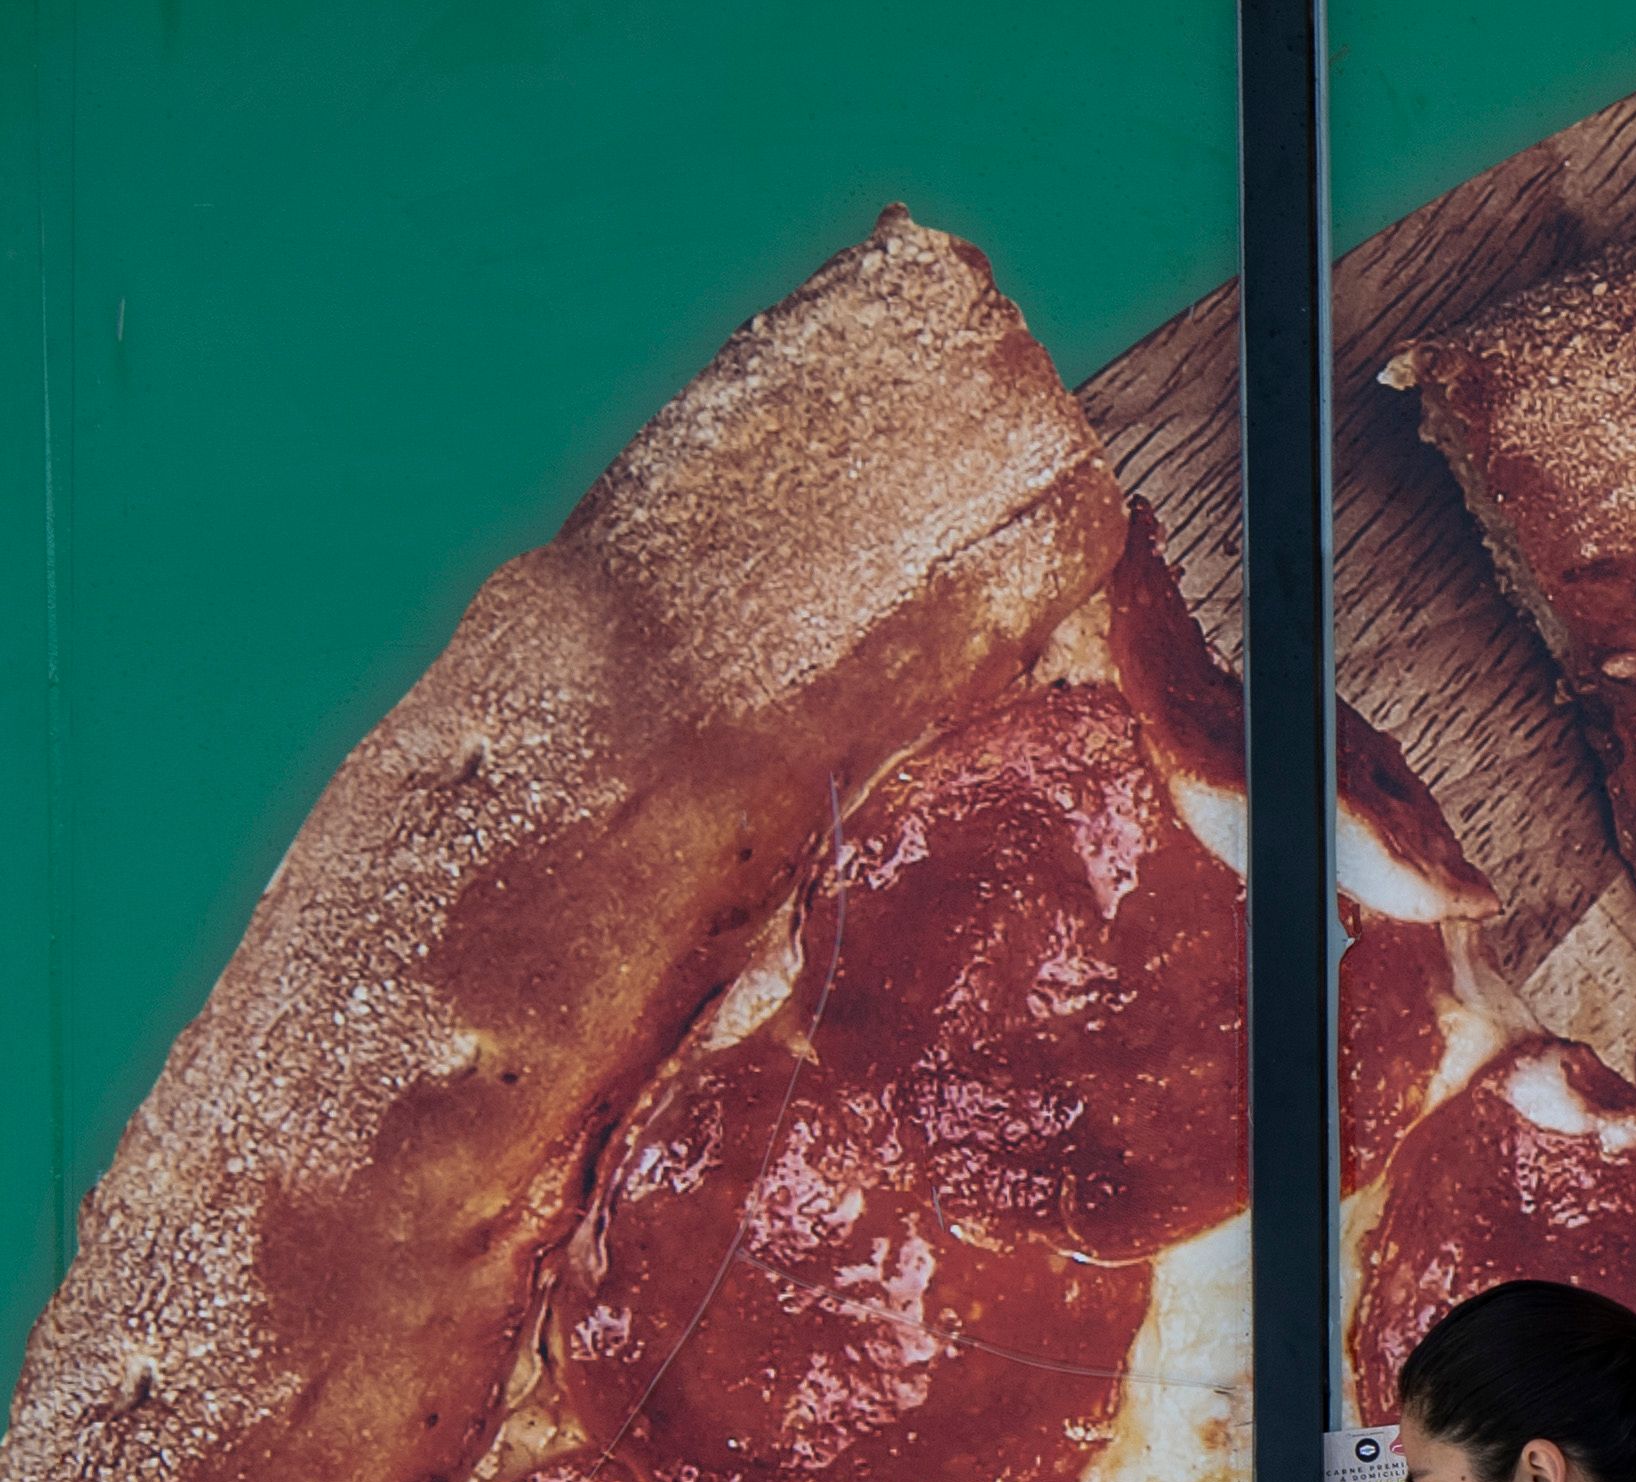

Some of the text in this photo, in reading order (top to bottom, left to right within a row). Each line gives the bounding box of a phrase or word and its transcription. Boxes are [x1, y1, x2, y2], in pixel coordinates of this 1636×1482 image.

[1326, 1462, 1406, 1477] CARNE PREMI
[1352, 1470, 1406, 1481] DOMICILI
